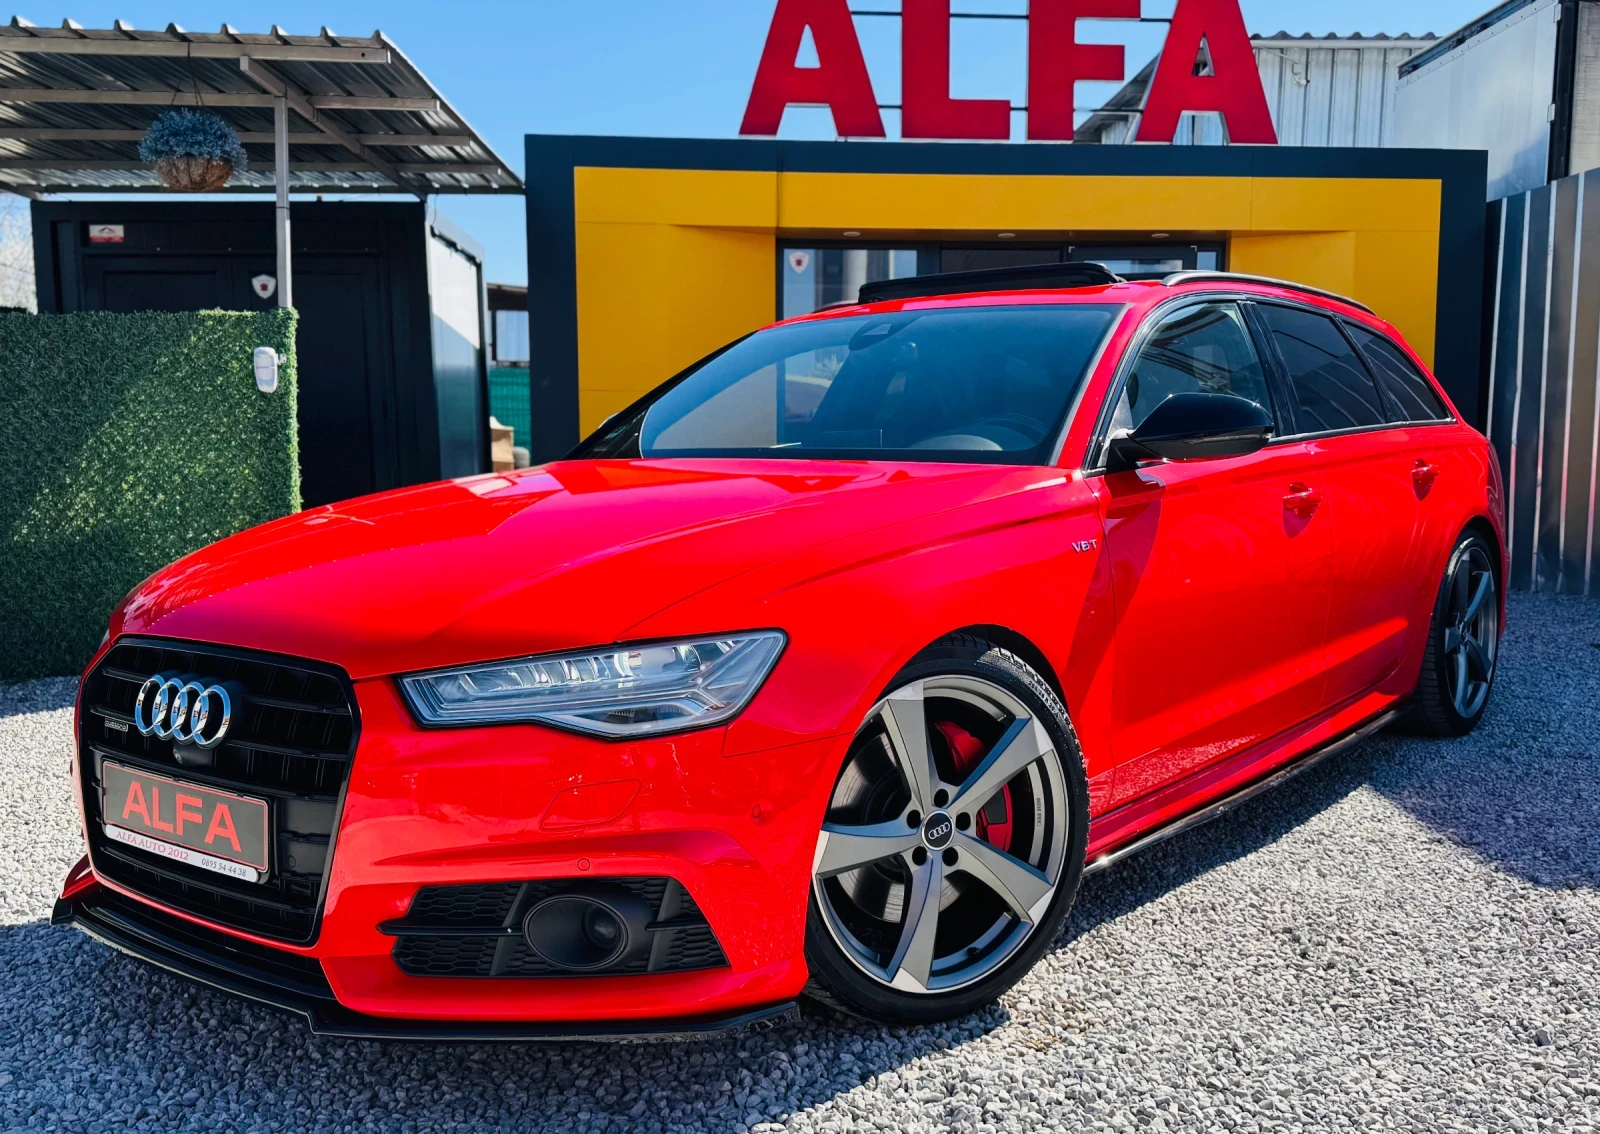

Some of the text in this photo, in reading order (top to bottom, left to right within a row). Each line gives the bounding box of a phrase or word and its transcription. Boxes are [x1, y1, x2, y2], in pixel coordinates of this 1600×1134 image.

[739, 0, 1278, 144] ALFA
[122, 781, 242, 853] ALFA
[116, 831, 189, 860] ALFA AUTO 2012
[201, 858, 247, 877] 0895 54 44 38
